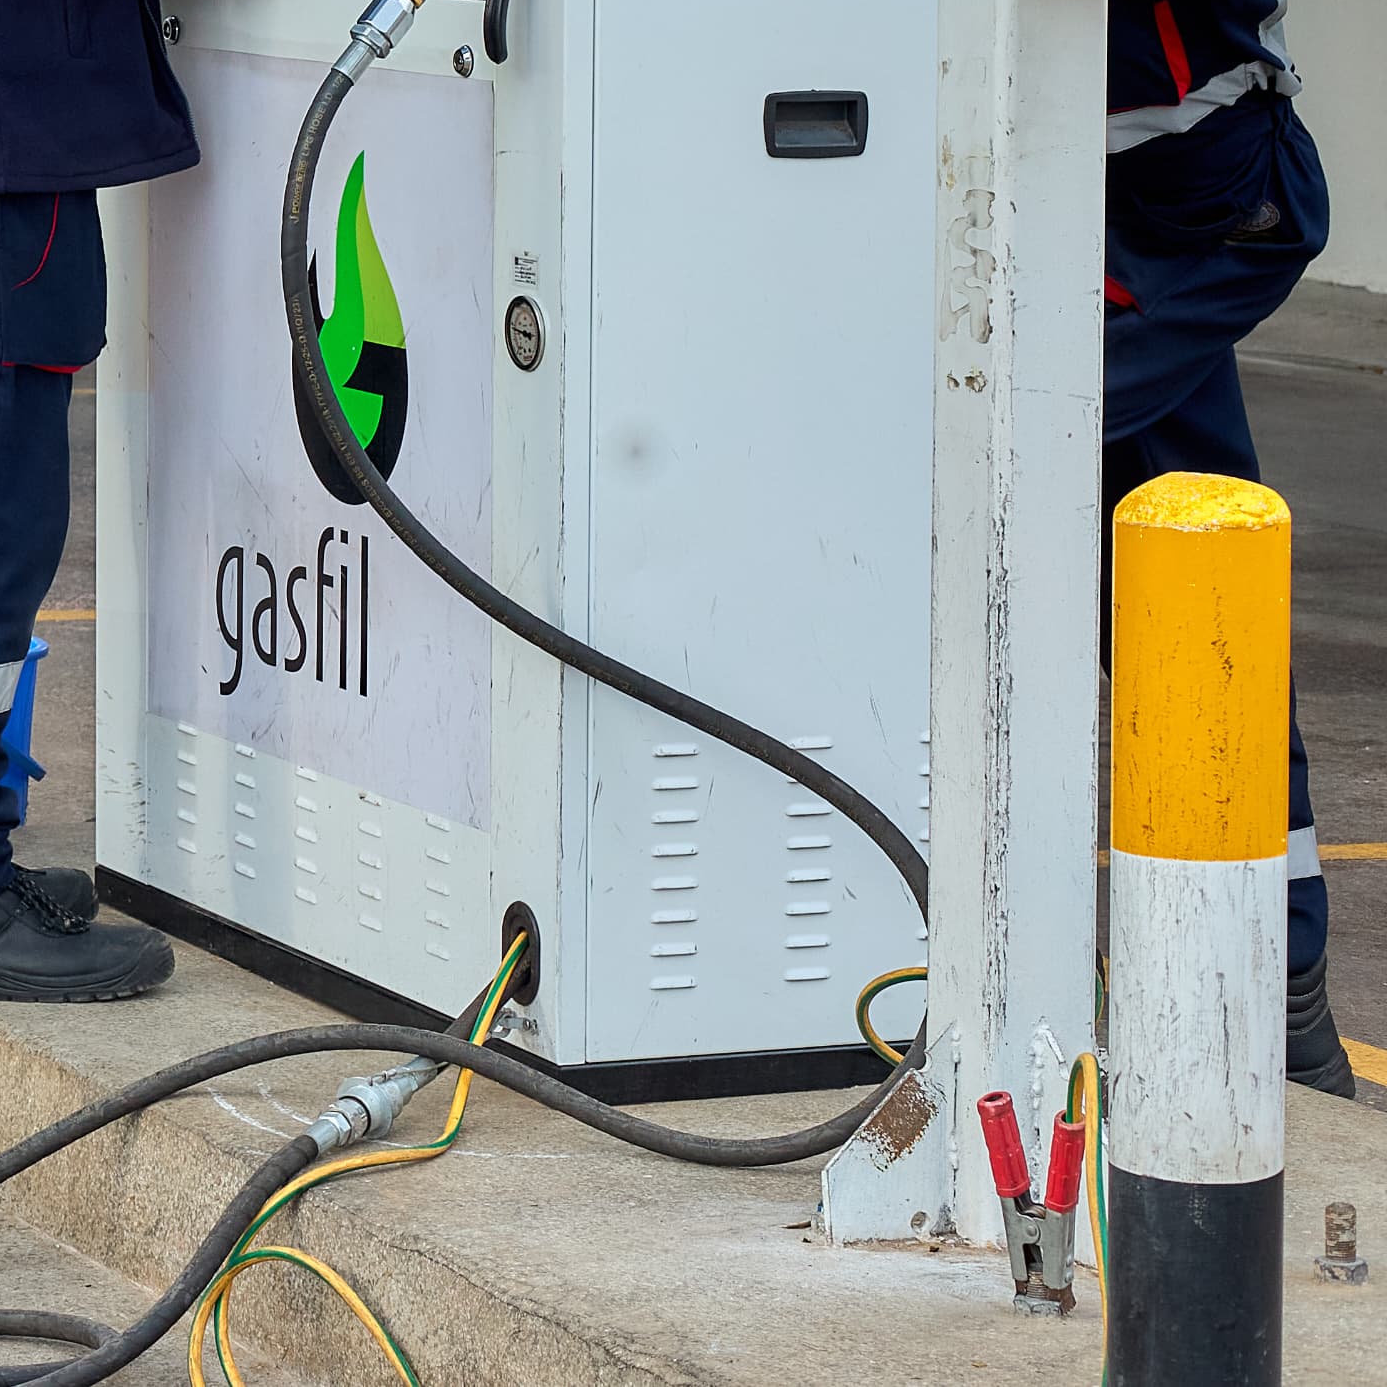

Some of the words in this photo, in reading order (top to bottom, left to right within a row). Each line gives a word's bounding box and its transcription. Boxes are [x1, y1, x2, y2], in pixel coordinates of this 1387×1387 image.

[308, 106, 326, 134] HOSE
[303, 136, 314, 157] LPG
[215, 526, 369, 698] gasfil
